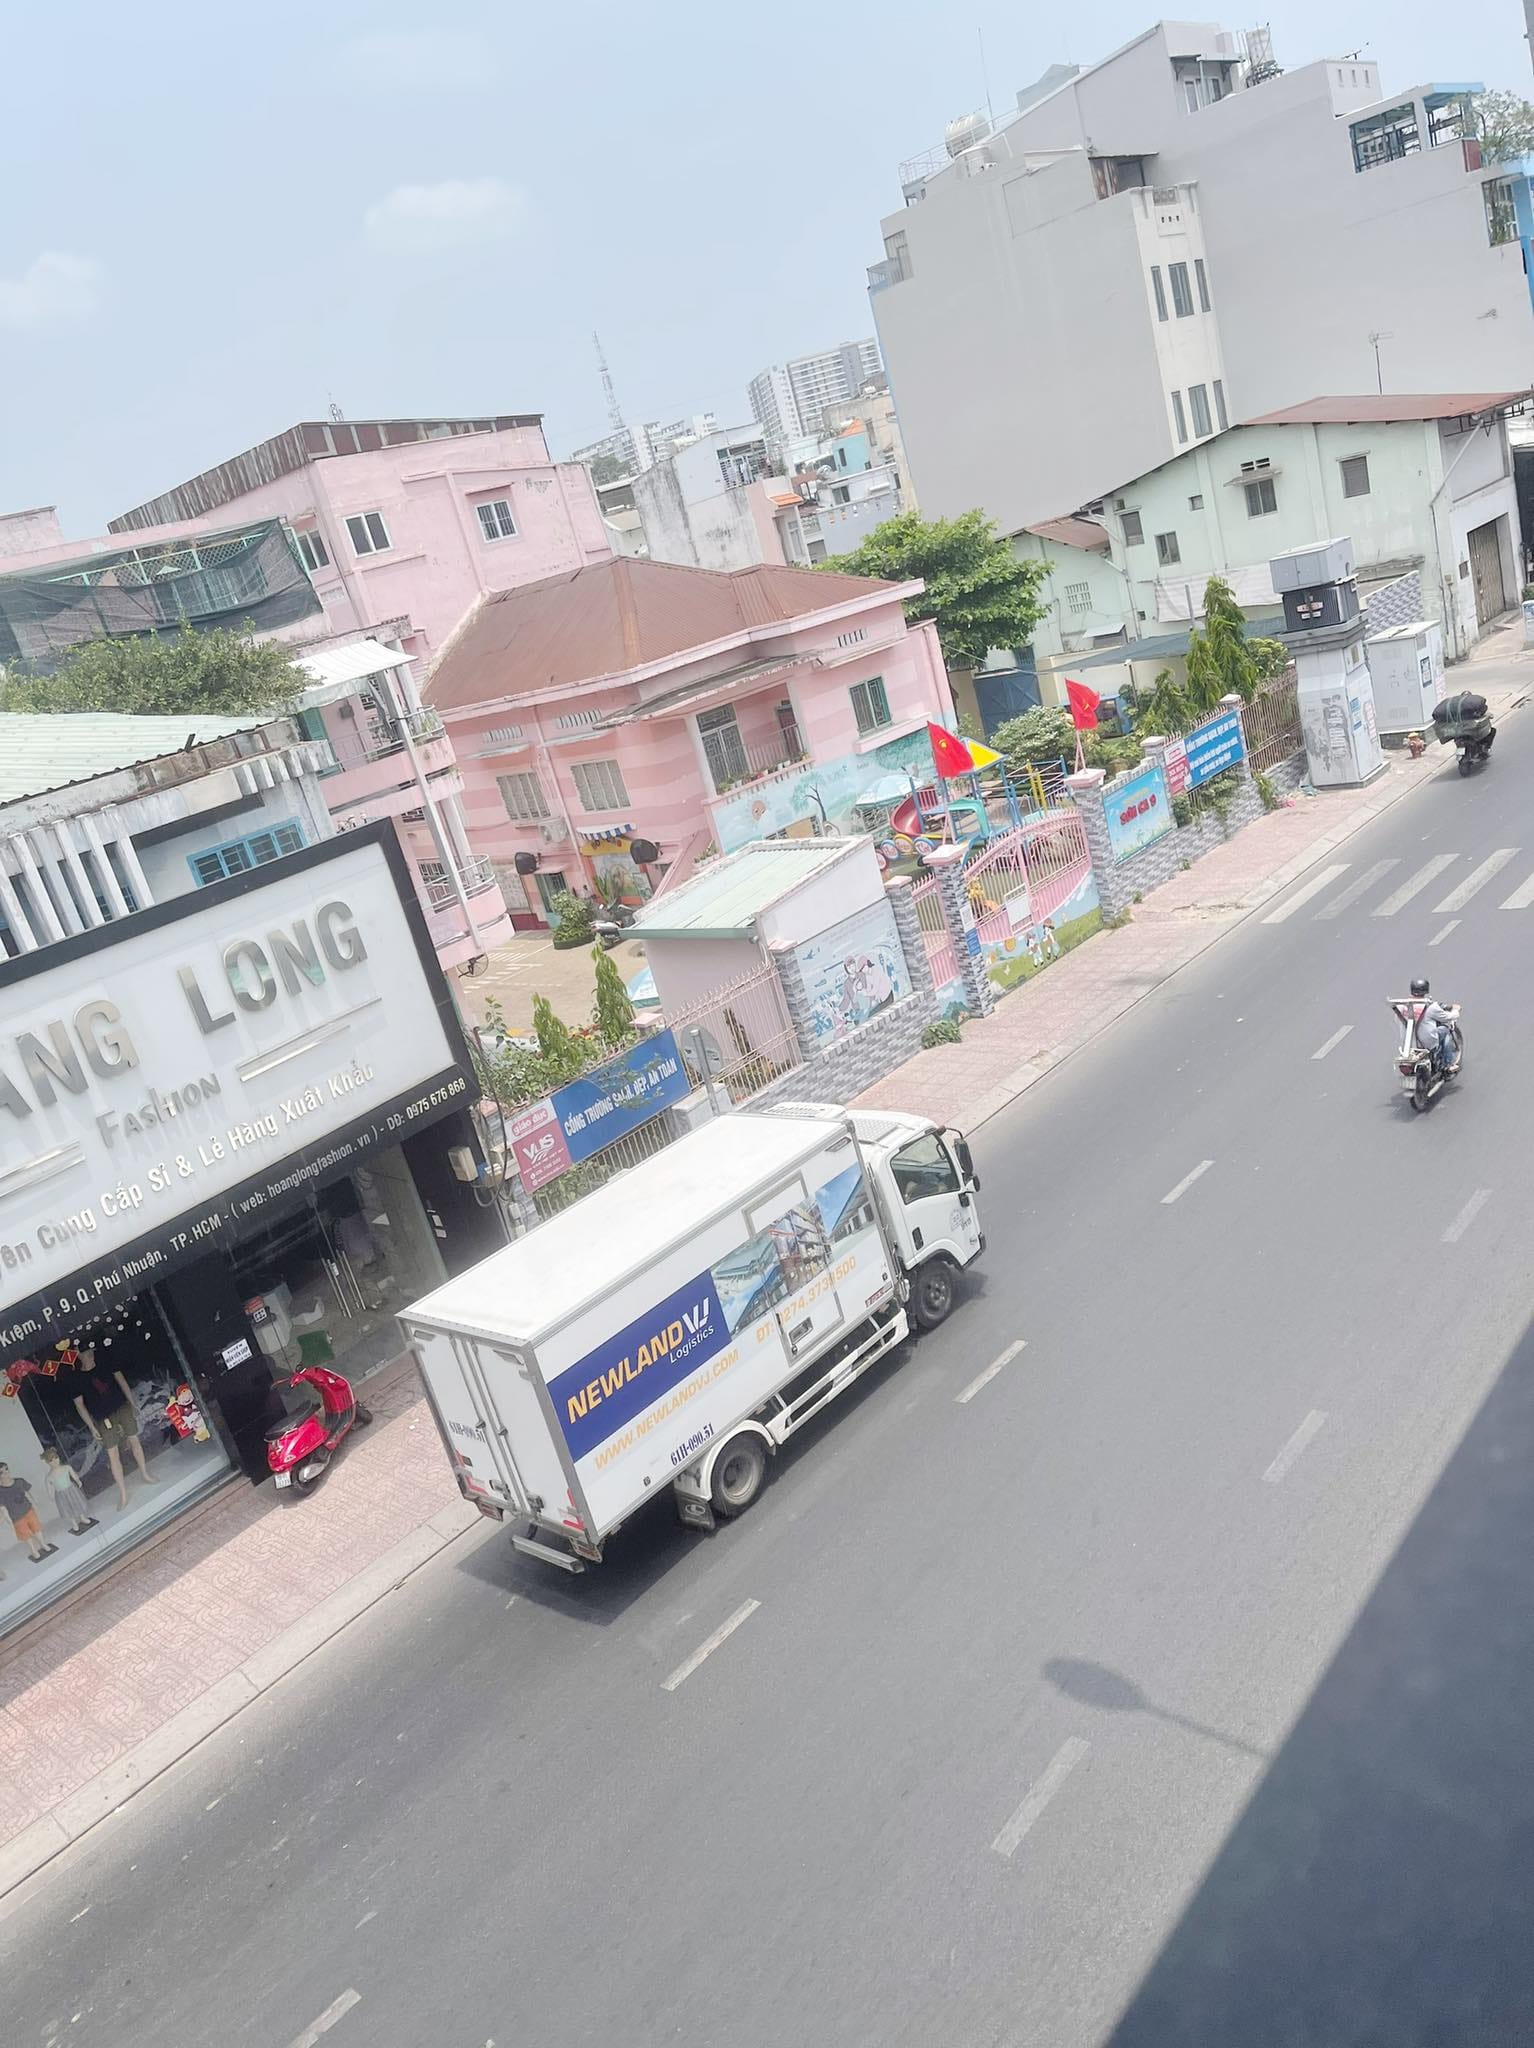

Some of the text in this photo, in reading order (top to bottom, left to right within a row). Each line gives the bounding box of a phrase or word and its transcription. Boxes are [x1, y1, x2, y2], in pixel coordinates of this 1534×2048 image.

[176, 901, 368, 1035] LONG
[406, 1097, 430, 1120] 0975
[429, 1087, 448, 1106] 676
[447, 1077, 466, 1096] 868
[37, 1207, 97, 1250] Cung
[100, 1181, 143, 1217] Cấp
[175, 1154, 194, 1178] &
[198, 1136, 225, 1168] Lẻ
[227, 1111, 279, 1151] Hàng
[327, 1059, 374, 1099] Khẩu
[522, 1133, 555, 1160] VUS
[669, 1324, 715, 1364] Logistics
[566, 1320, 685, 1425] NEWLAND
[670, 1422, 714, 1466] 61H-090.51
